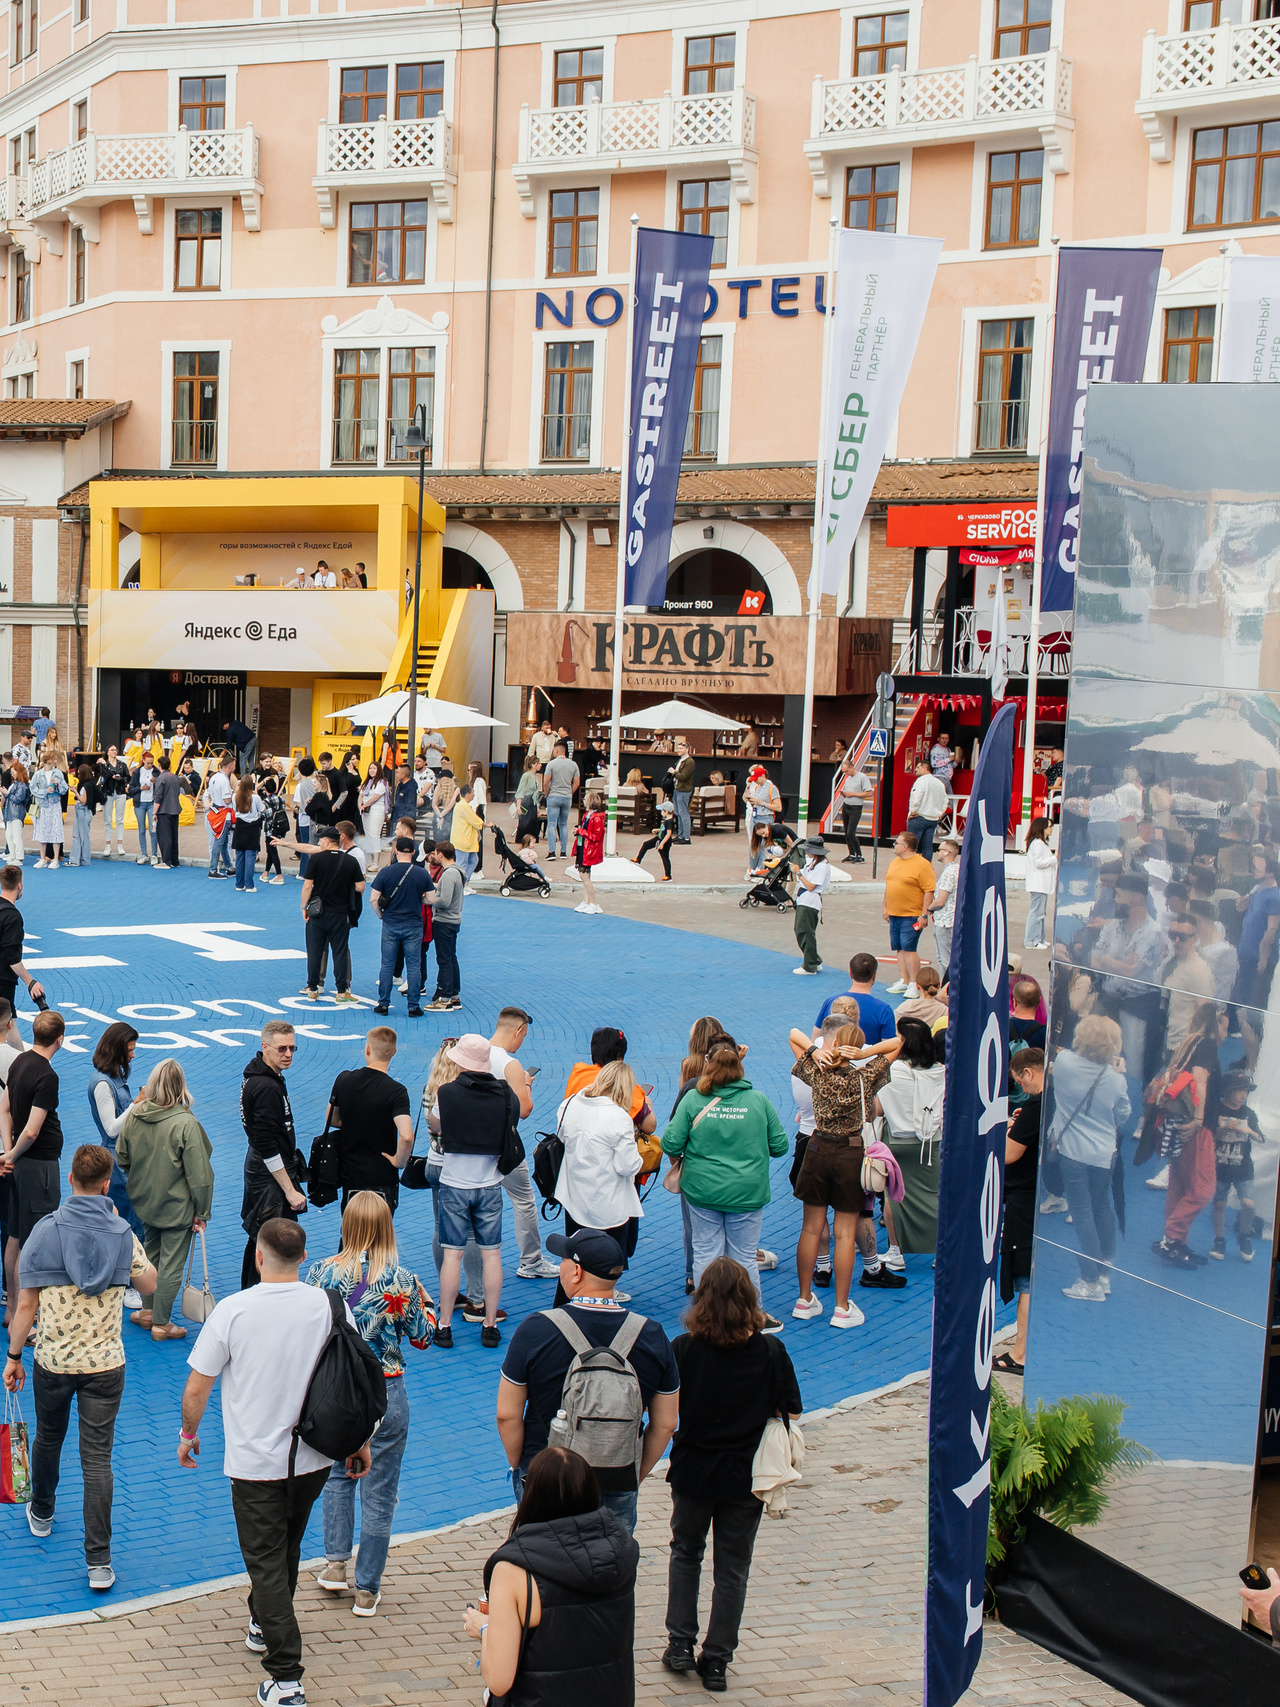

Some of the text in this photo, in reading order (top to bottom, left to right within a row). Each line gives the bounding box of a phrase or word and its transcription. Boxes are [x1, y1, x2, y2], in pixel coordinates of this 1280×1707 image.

[849, 273, 879, 379] ГЕНЕРАЛЬНЫЙ
[865, 315, 888, 382] ПАРТНЁР
[627, 272, 684, 566] GASTREET
[832, 392, 869, 500] СБЕР
[240, 541, 296, 550] возможностей
[303, 542, 332, 550] Яндекс
[333, 541, 353, 550] Едой
[695, 600, 713, 609] 960
[184, 622, 297, 641] Яндекс Еда
[184, 671, 239, 685] Доставка
[626, 676, 735, 688] СДЕЛАНО ВРУЧНУЮ
